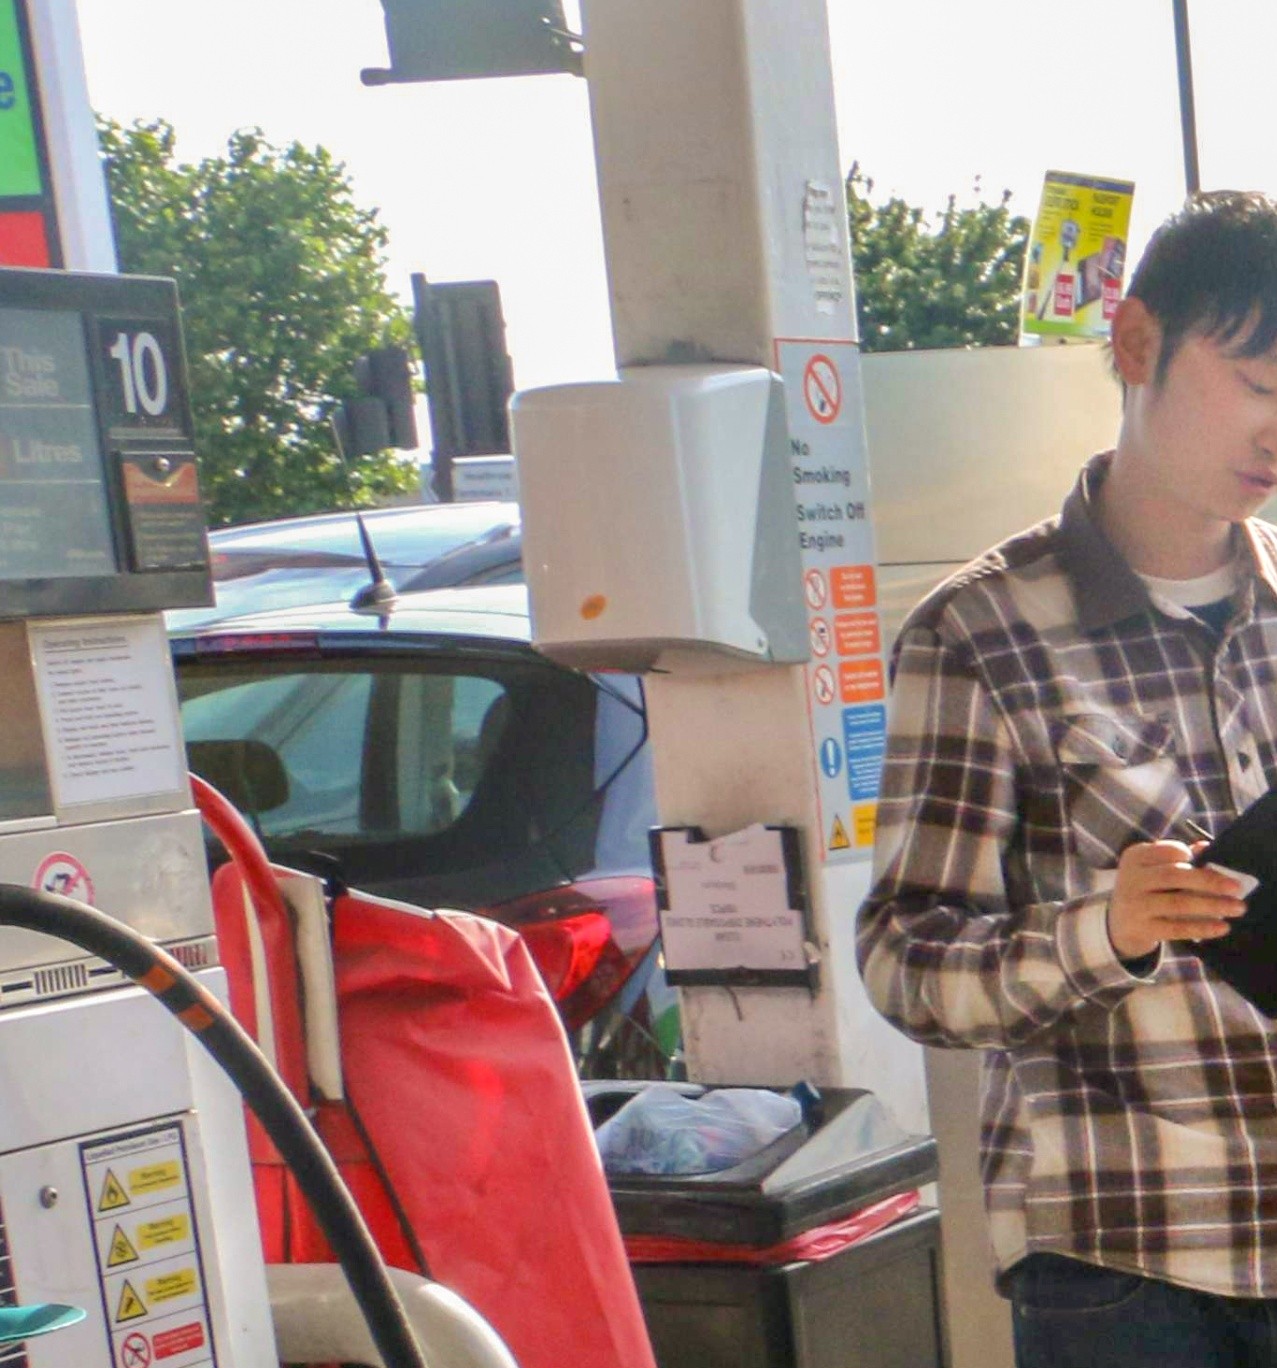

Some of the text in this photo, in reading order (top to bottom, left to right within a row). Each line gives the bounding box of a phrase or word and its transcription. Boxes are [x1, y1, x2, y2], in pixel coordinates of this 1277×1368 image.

[110, 332, 168, 416] 10
[13, 438, 83, 463] Litres
[791, 438, 809, 456] No
[793, 466, 851, 488] Smoking
[797, 502, 865, 521] Switch Off
[799, 531, 844, 552] Engine
